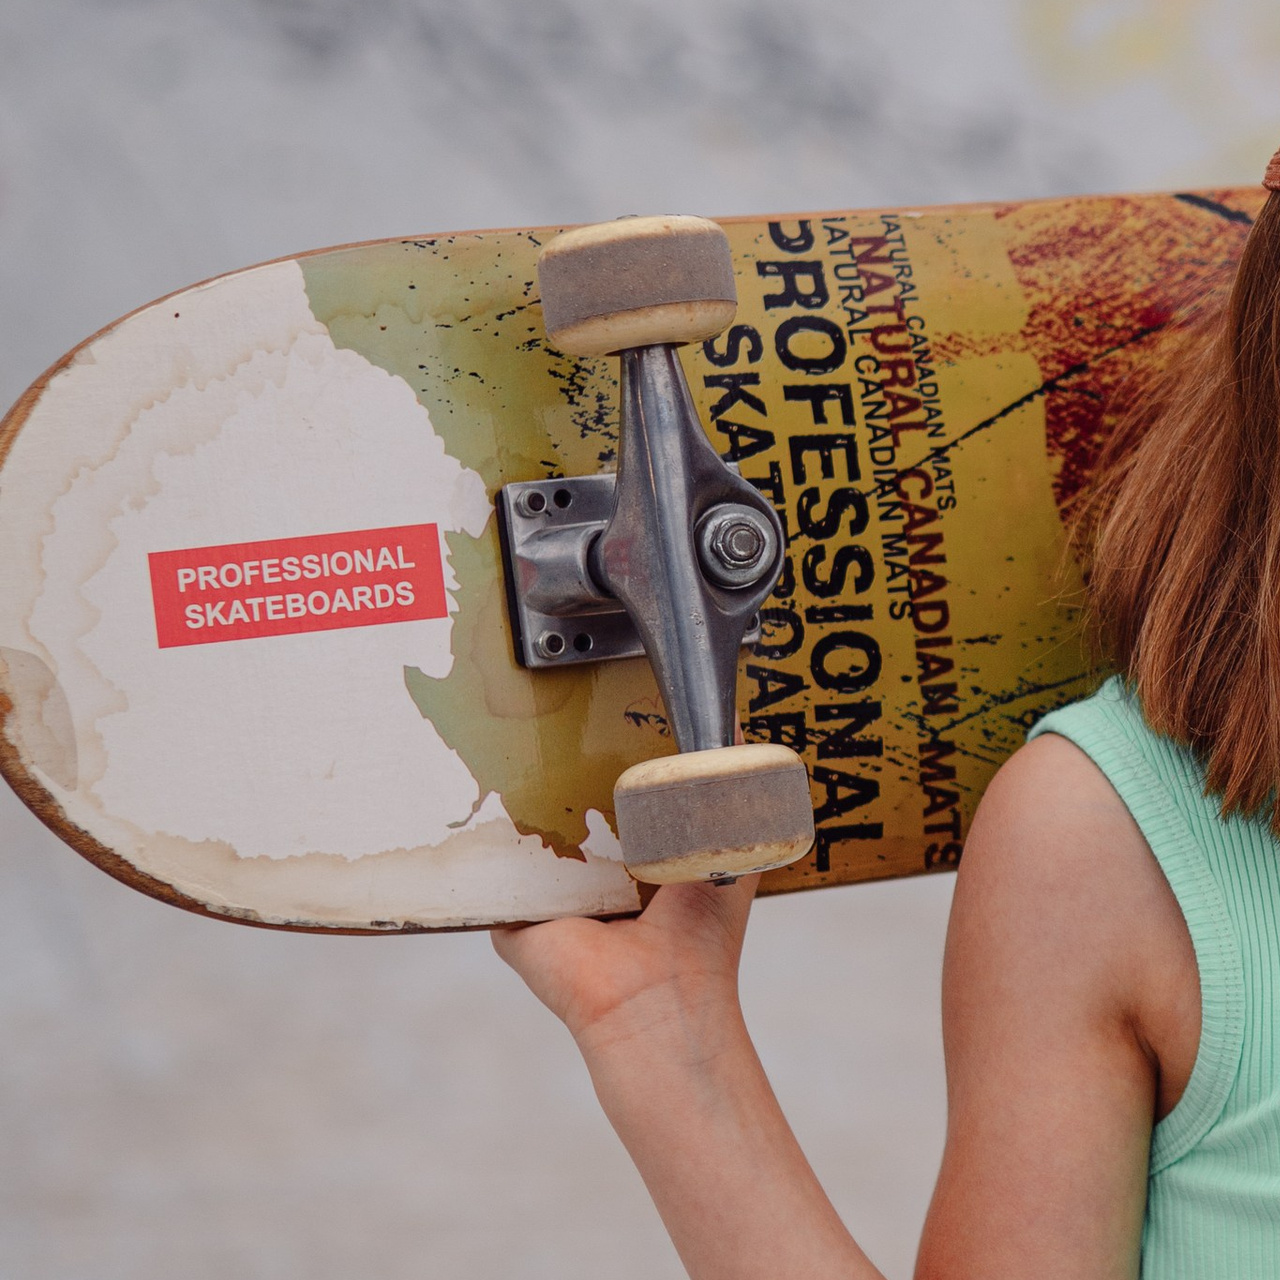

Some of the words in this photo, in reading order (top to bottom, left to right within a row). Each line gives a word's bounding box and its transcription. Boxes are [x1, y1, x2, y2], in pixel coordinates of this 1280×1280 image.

[851, 236, 928, 448] NATURAL
[906, 316, 946, 438] CANADIAN
[854, 354, 905, 522] CANADIAN
[881, 532, 915, 621] MATS
[177, 546, 415, 592] PROFESSIONAL
[185, 581, 415, 629] SKATEBOARDS
[895, 469, 960, 716] CANADIAN
[918, 740, 963, 869] MATS
